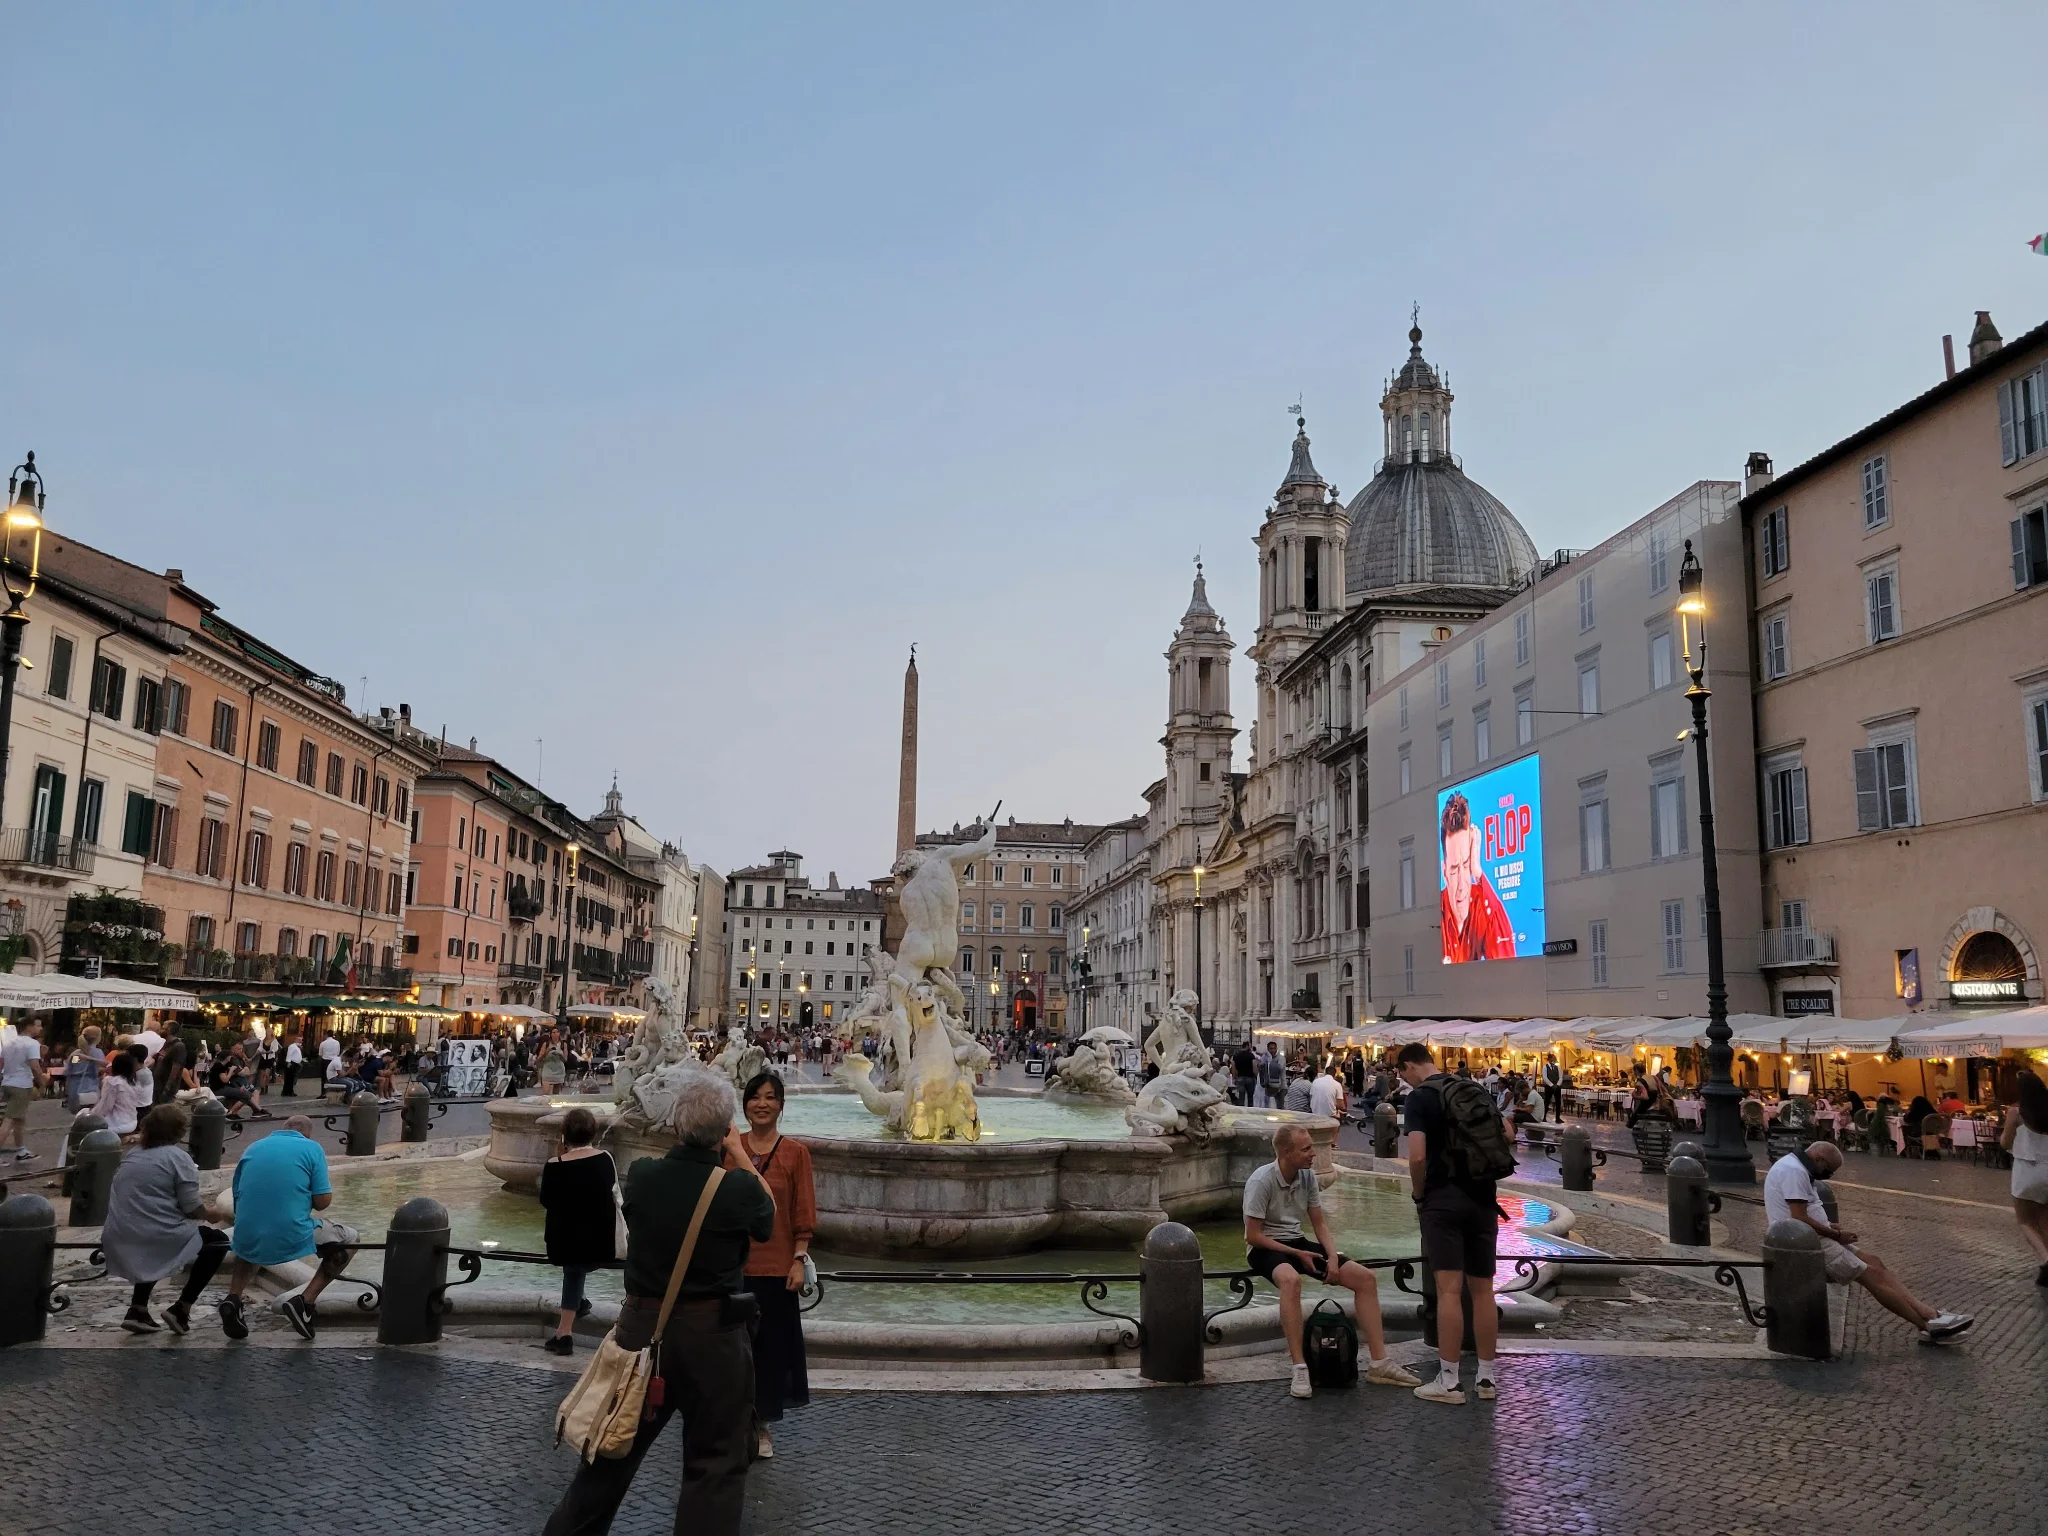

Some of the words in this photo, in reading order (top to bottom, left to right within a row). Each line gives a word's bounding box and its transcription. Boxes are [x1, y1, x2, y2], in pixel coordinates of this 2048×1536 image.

[1485, 804, 1531, 861] FLOP
[1494, 867, 1499, 879] IL
[1952, 983, 2018, 996] RISTORANTE
[41, 998, 61, 1007] OFFEE
[175, 999, 195, 1008] PIZZA
[1786, 999, 1800, 1010] TRE
[1801, 998, 1829, 1010] SCALINI
